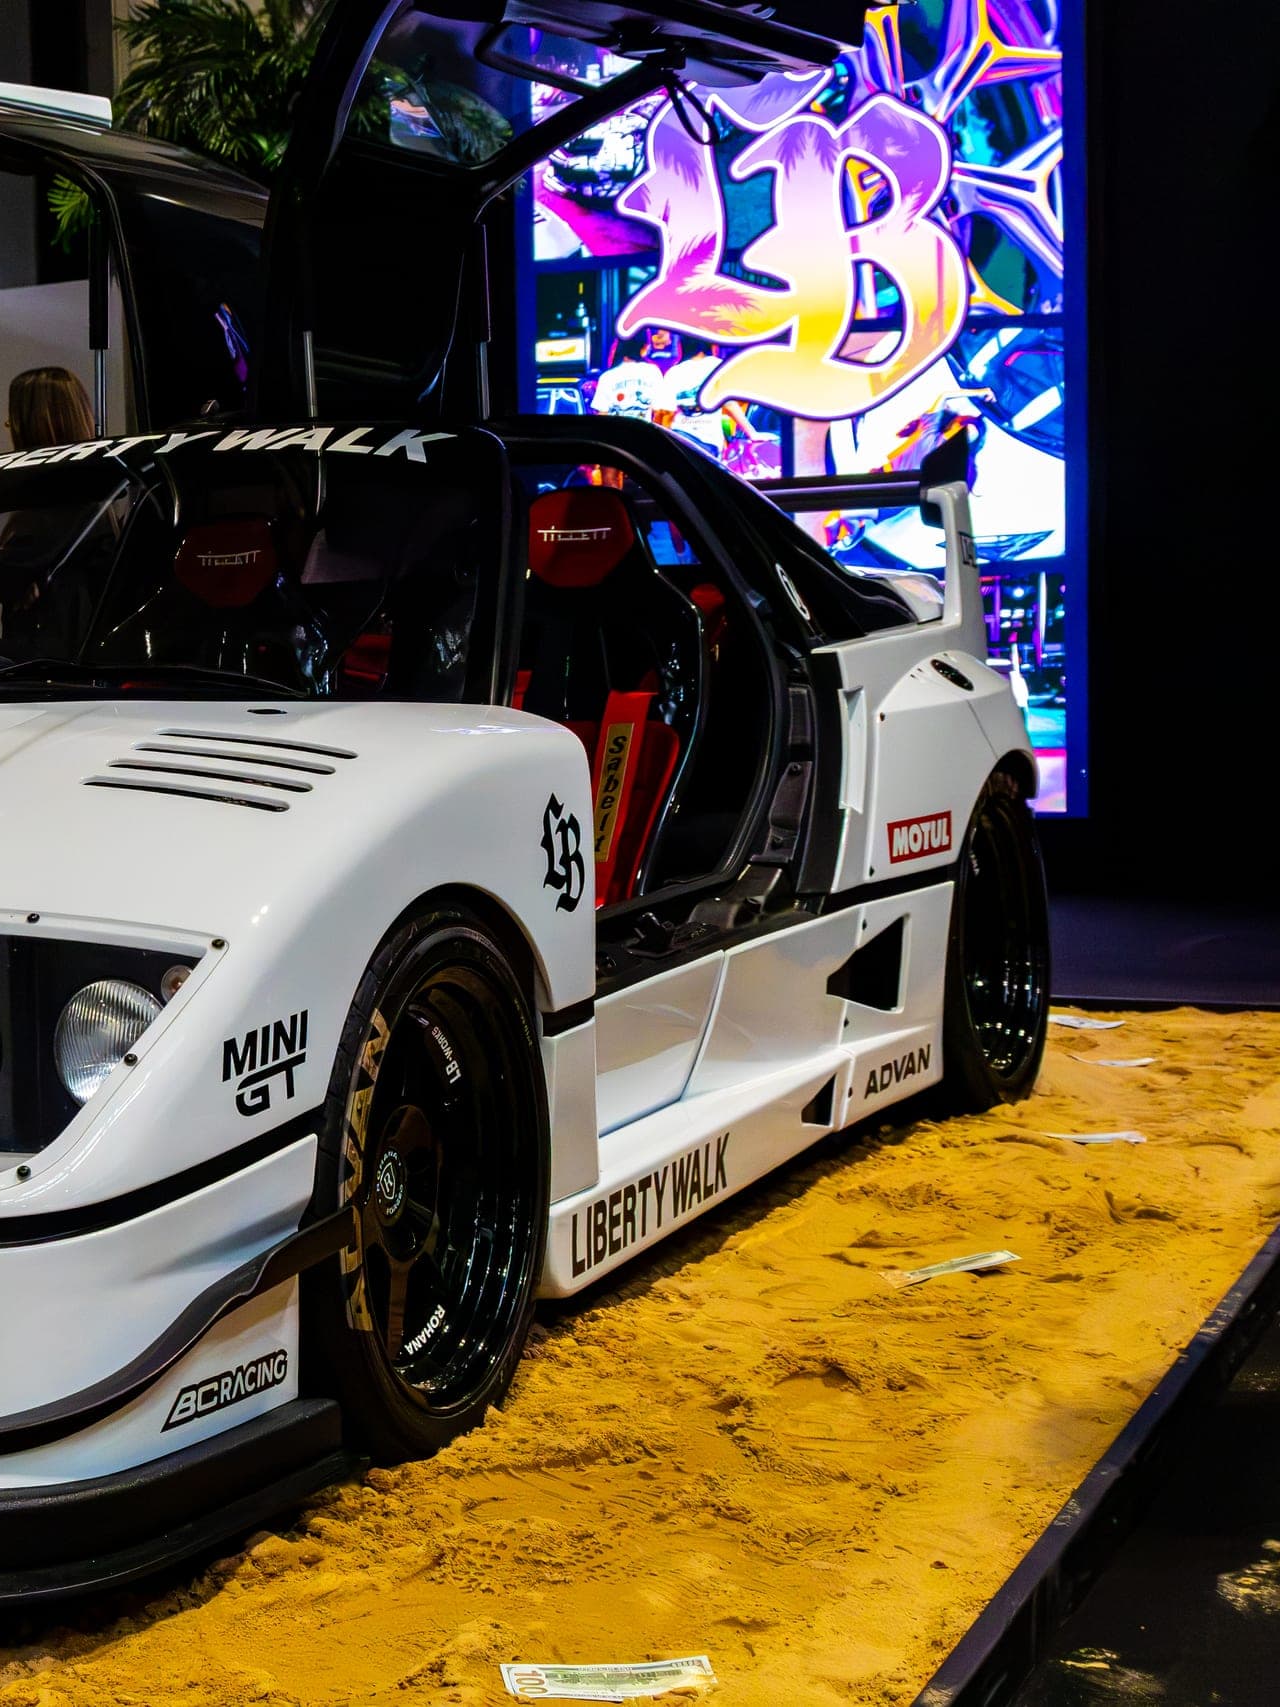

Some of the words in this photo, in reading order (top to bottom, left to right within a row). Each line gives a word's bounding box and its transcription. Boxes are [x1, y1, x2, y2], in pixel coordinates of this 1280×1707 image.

[213, 427, 457, 463] WALK
[594, 736, 628, 852] Sabelt
[540, 792, 585, 913] LB
[892, 817, 950, 857] MOTUL
[221, 1009, 309, 1082] MINI
[864, 1044, 930, 1100] ADVAN
[235, 1053, 306, 1117] GT
[572, 1165, 669, 1279] LIBERTY
[672, 1132, 730, 1219] WALK
[404, 1304, 446, 1355] ROHANA
